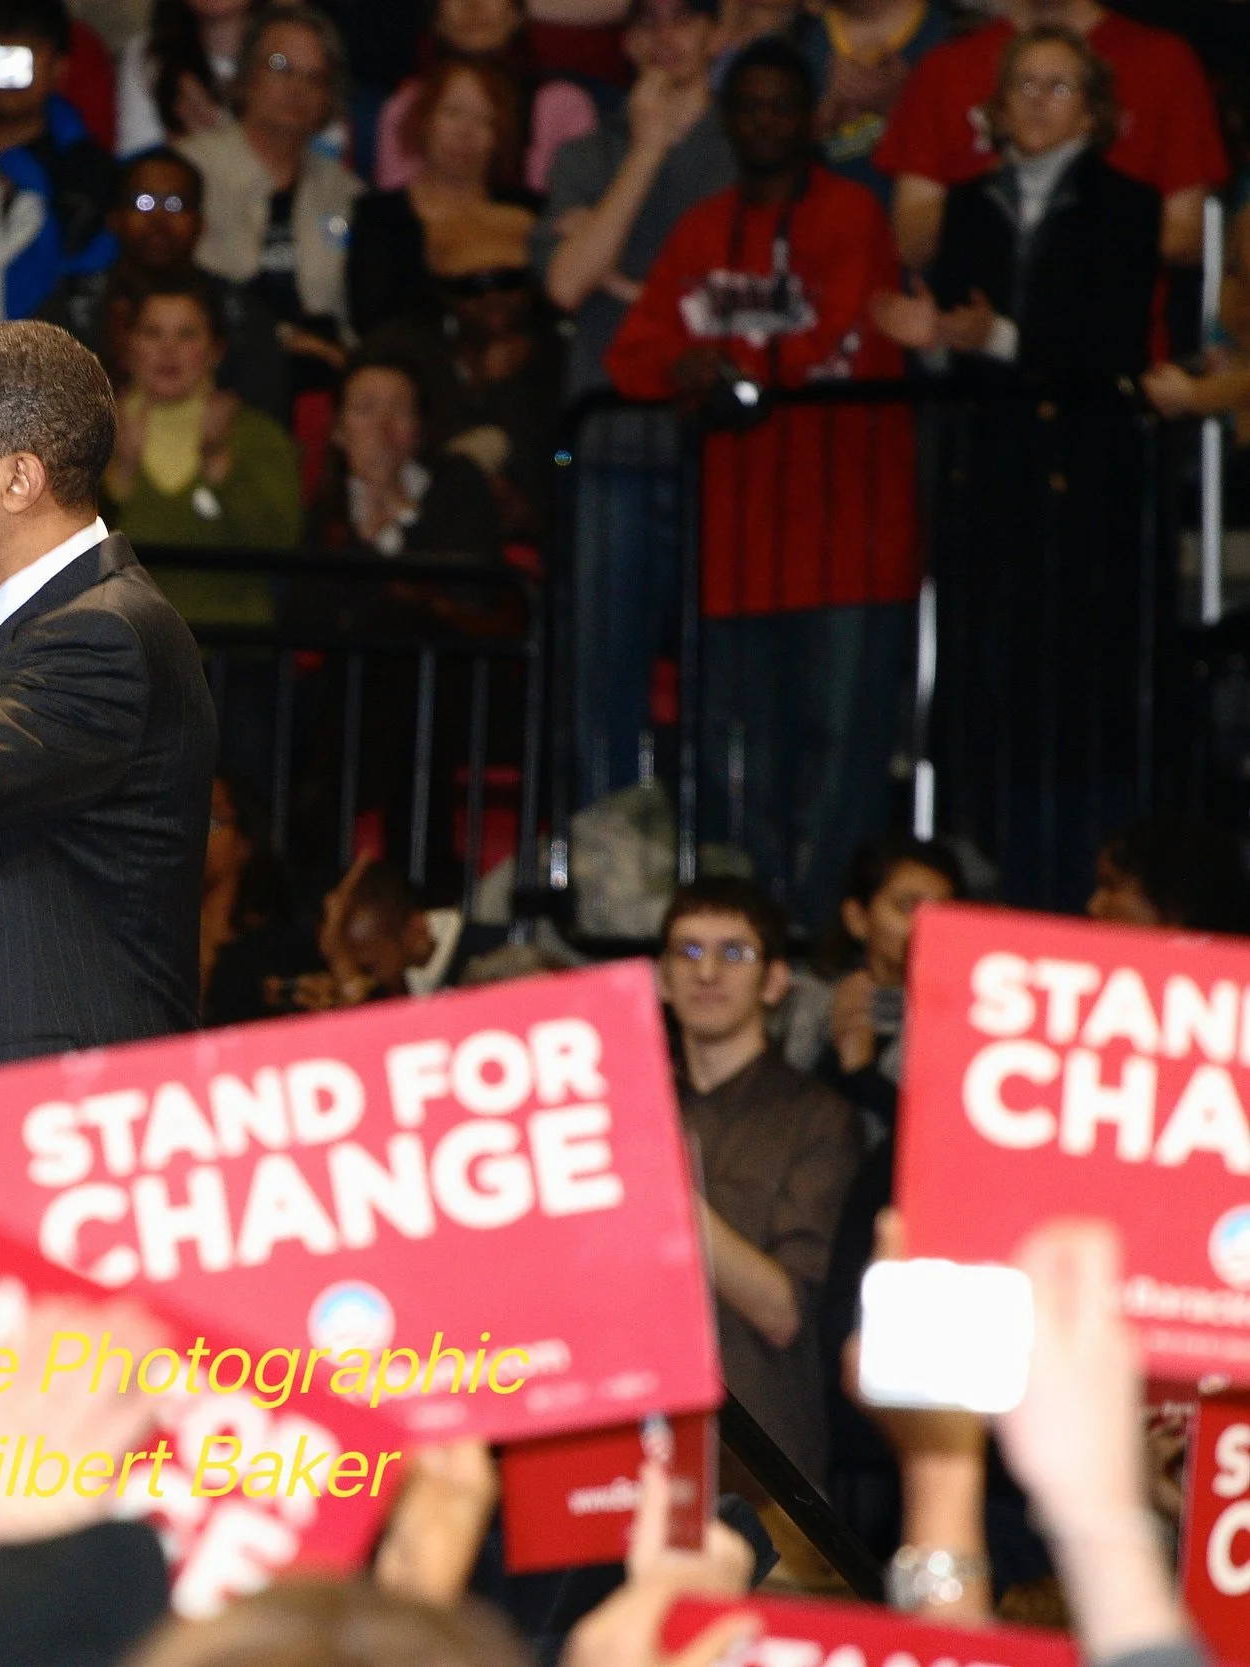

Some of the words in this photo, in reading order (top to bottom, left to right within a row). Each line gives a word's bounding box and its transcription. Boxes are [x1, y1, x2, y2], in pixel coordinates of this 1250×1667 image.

[969, 952, 1250, 1063] STAN
[22, 1057, 366, 1187] STAND
[385, 1017, 607, 1127] FOR
[962, 1040, 1250, 1174] CHA
[39, 1102, 625, 1286] CHANGE
